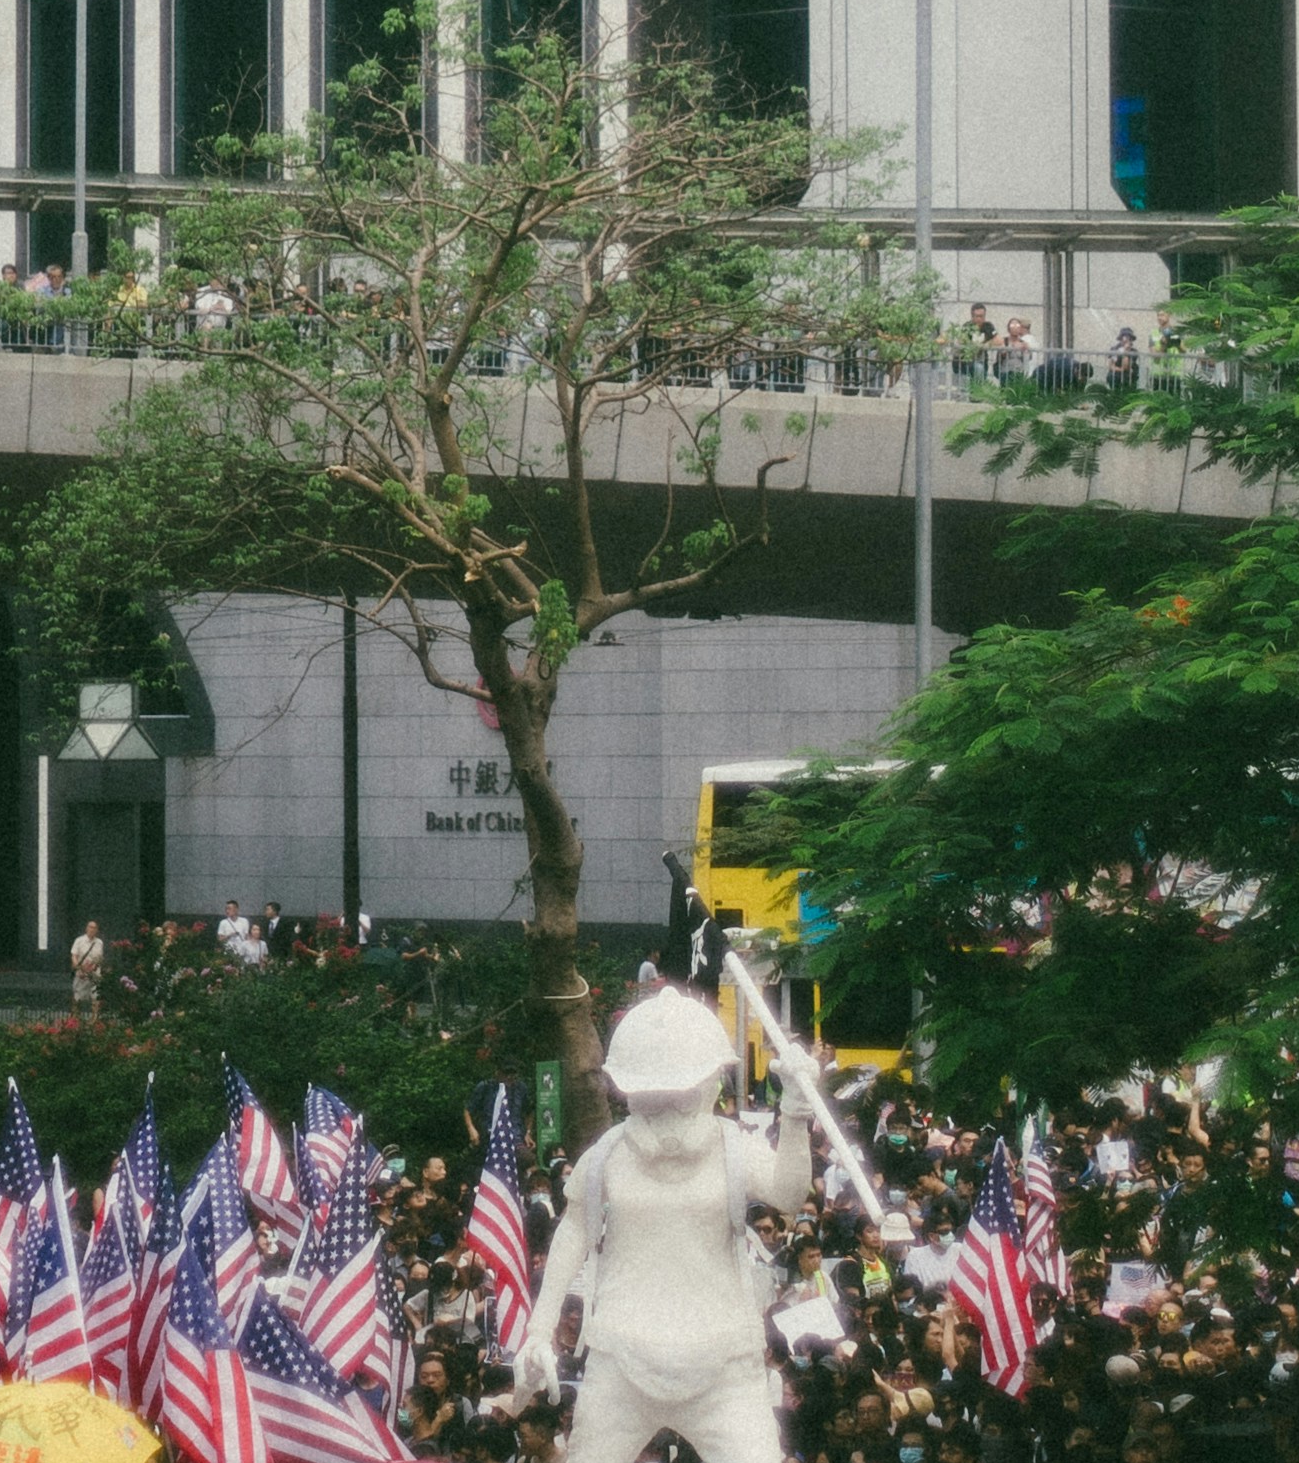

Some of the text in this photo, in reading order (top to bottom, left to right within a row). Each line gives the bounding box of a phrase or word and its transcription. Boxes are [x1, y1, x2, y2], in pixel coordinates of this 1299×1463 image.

[450, 759, 552, 796] 中銀大
[426, 811, 463, 832] Bank
[467, 811, 482, 832] of
